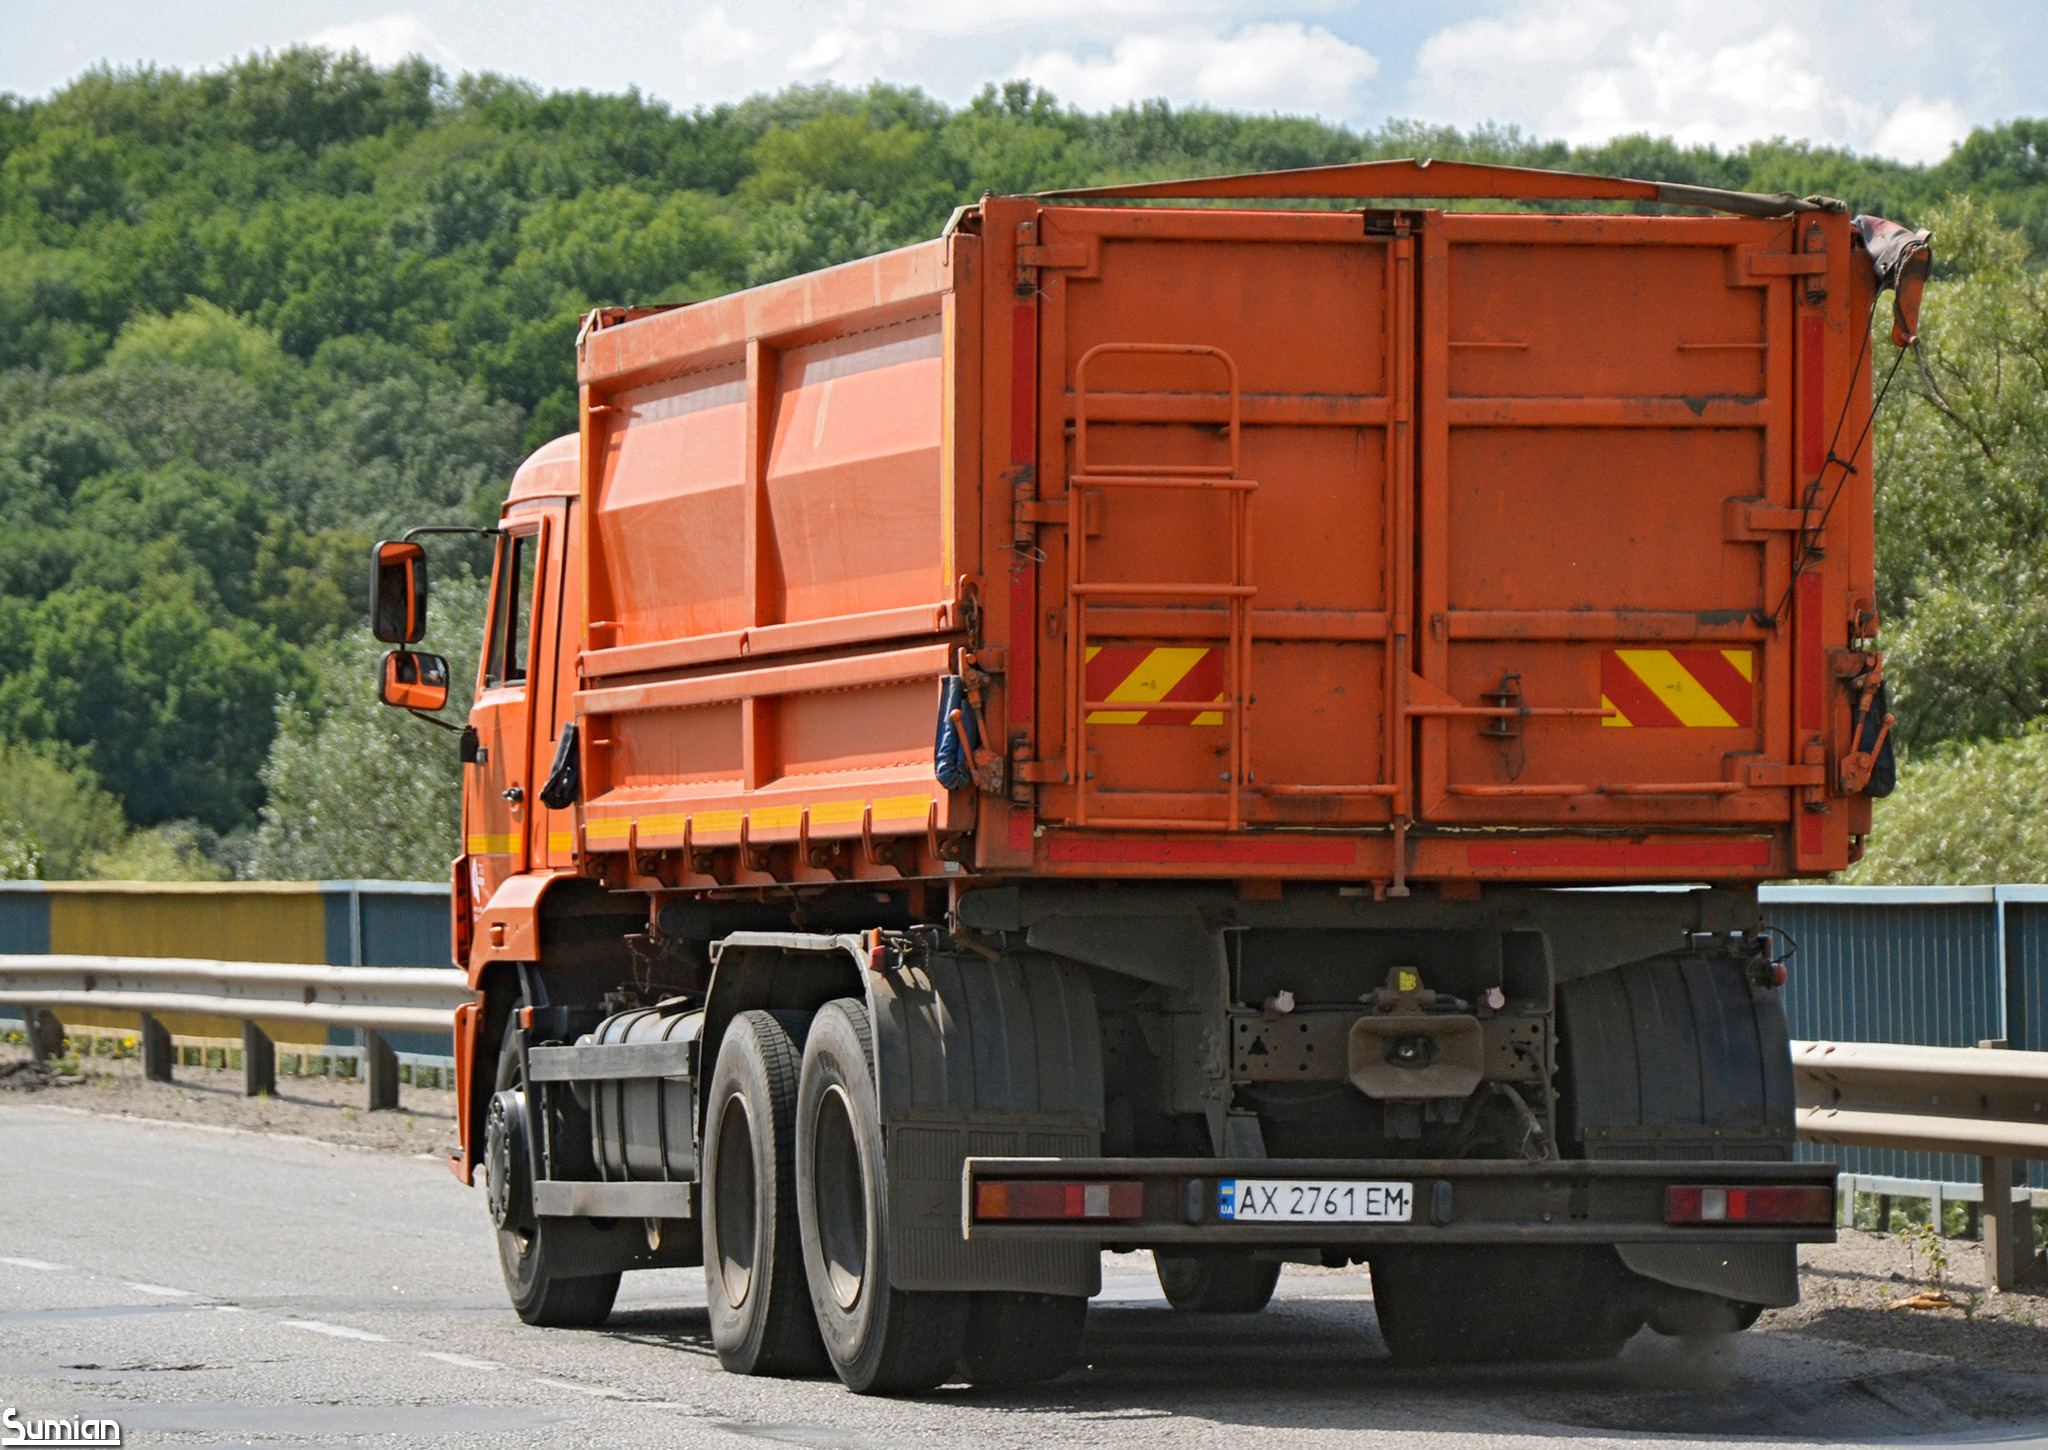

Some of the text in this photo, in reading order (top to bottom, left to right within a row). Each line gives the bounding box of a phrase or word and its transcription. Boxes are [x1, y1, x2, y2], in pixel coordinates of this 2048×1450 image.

[1220, 1204, 1234, 1215] UA
[1239, 1186, 1404, 1217] AX 2761 EM
